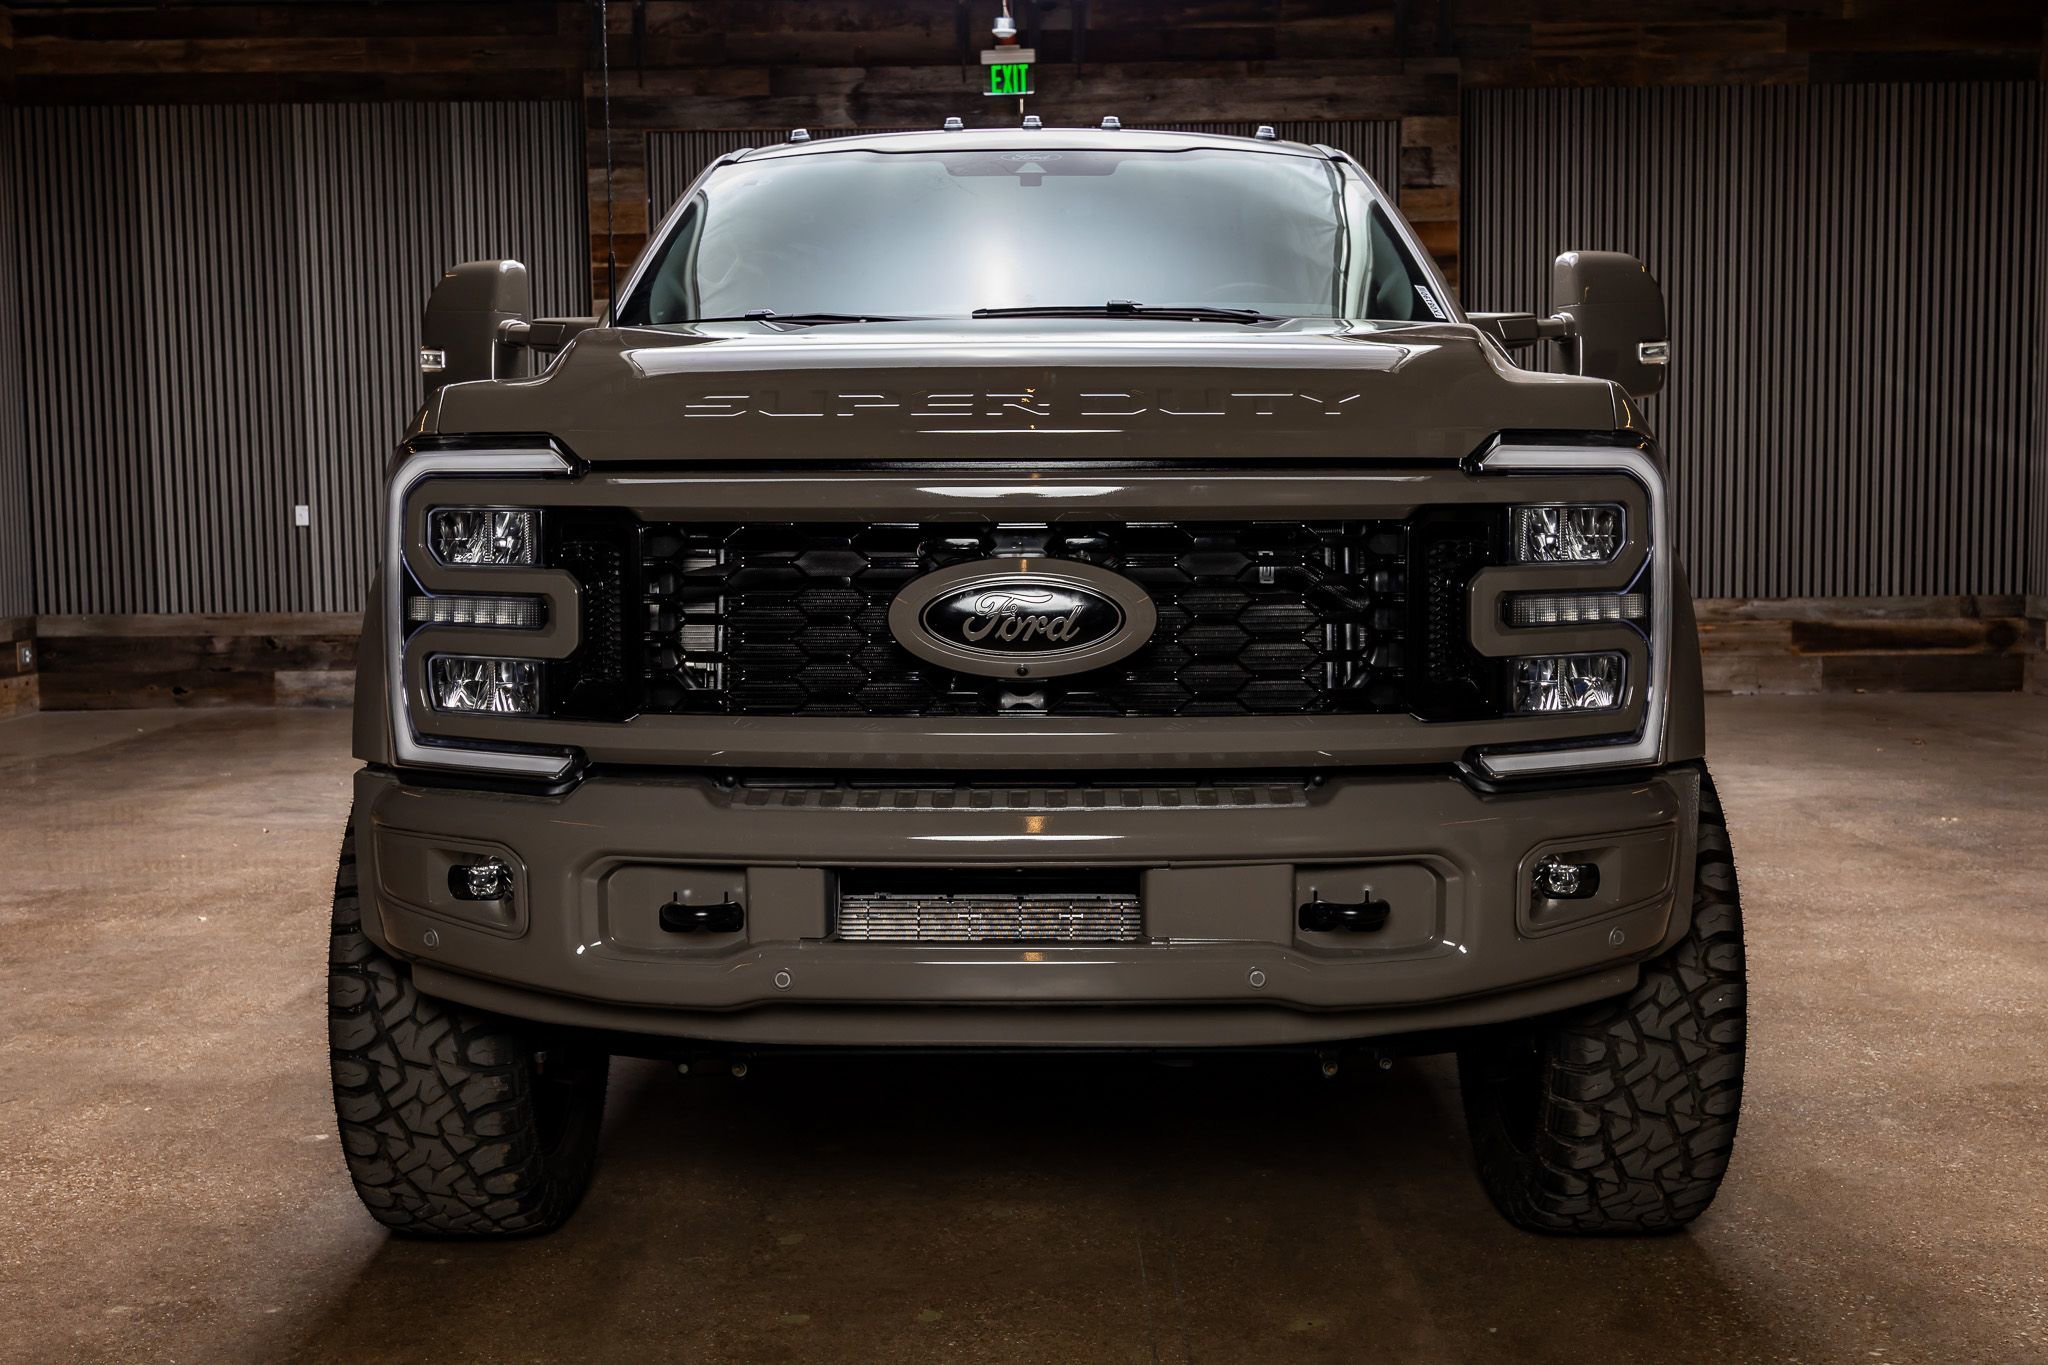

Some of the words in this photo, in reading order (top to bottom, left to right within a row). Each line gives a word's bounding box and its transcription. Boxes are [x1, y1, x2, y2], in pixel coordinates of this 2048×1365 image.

[990, 63, 1029, 94] EXIT
[683, 391, 1051, 418] SUPER
[1078, 390, 1362, 417] DUTY
[962, 591, 1085, 642] Ford
